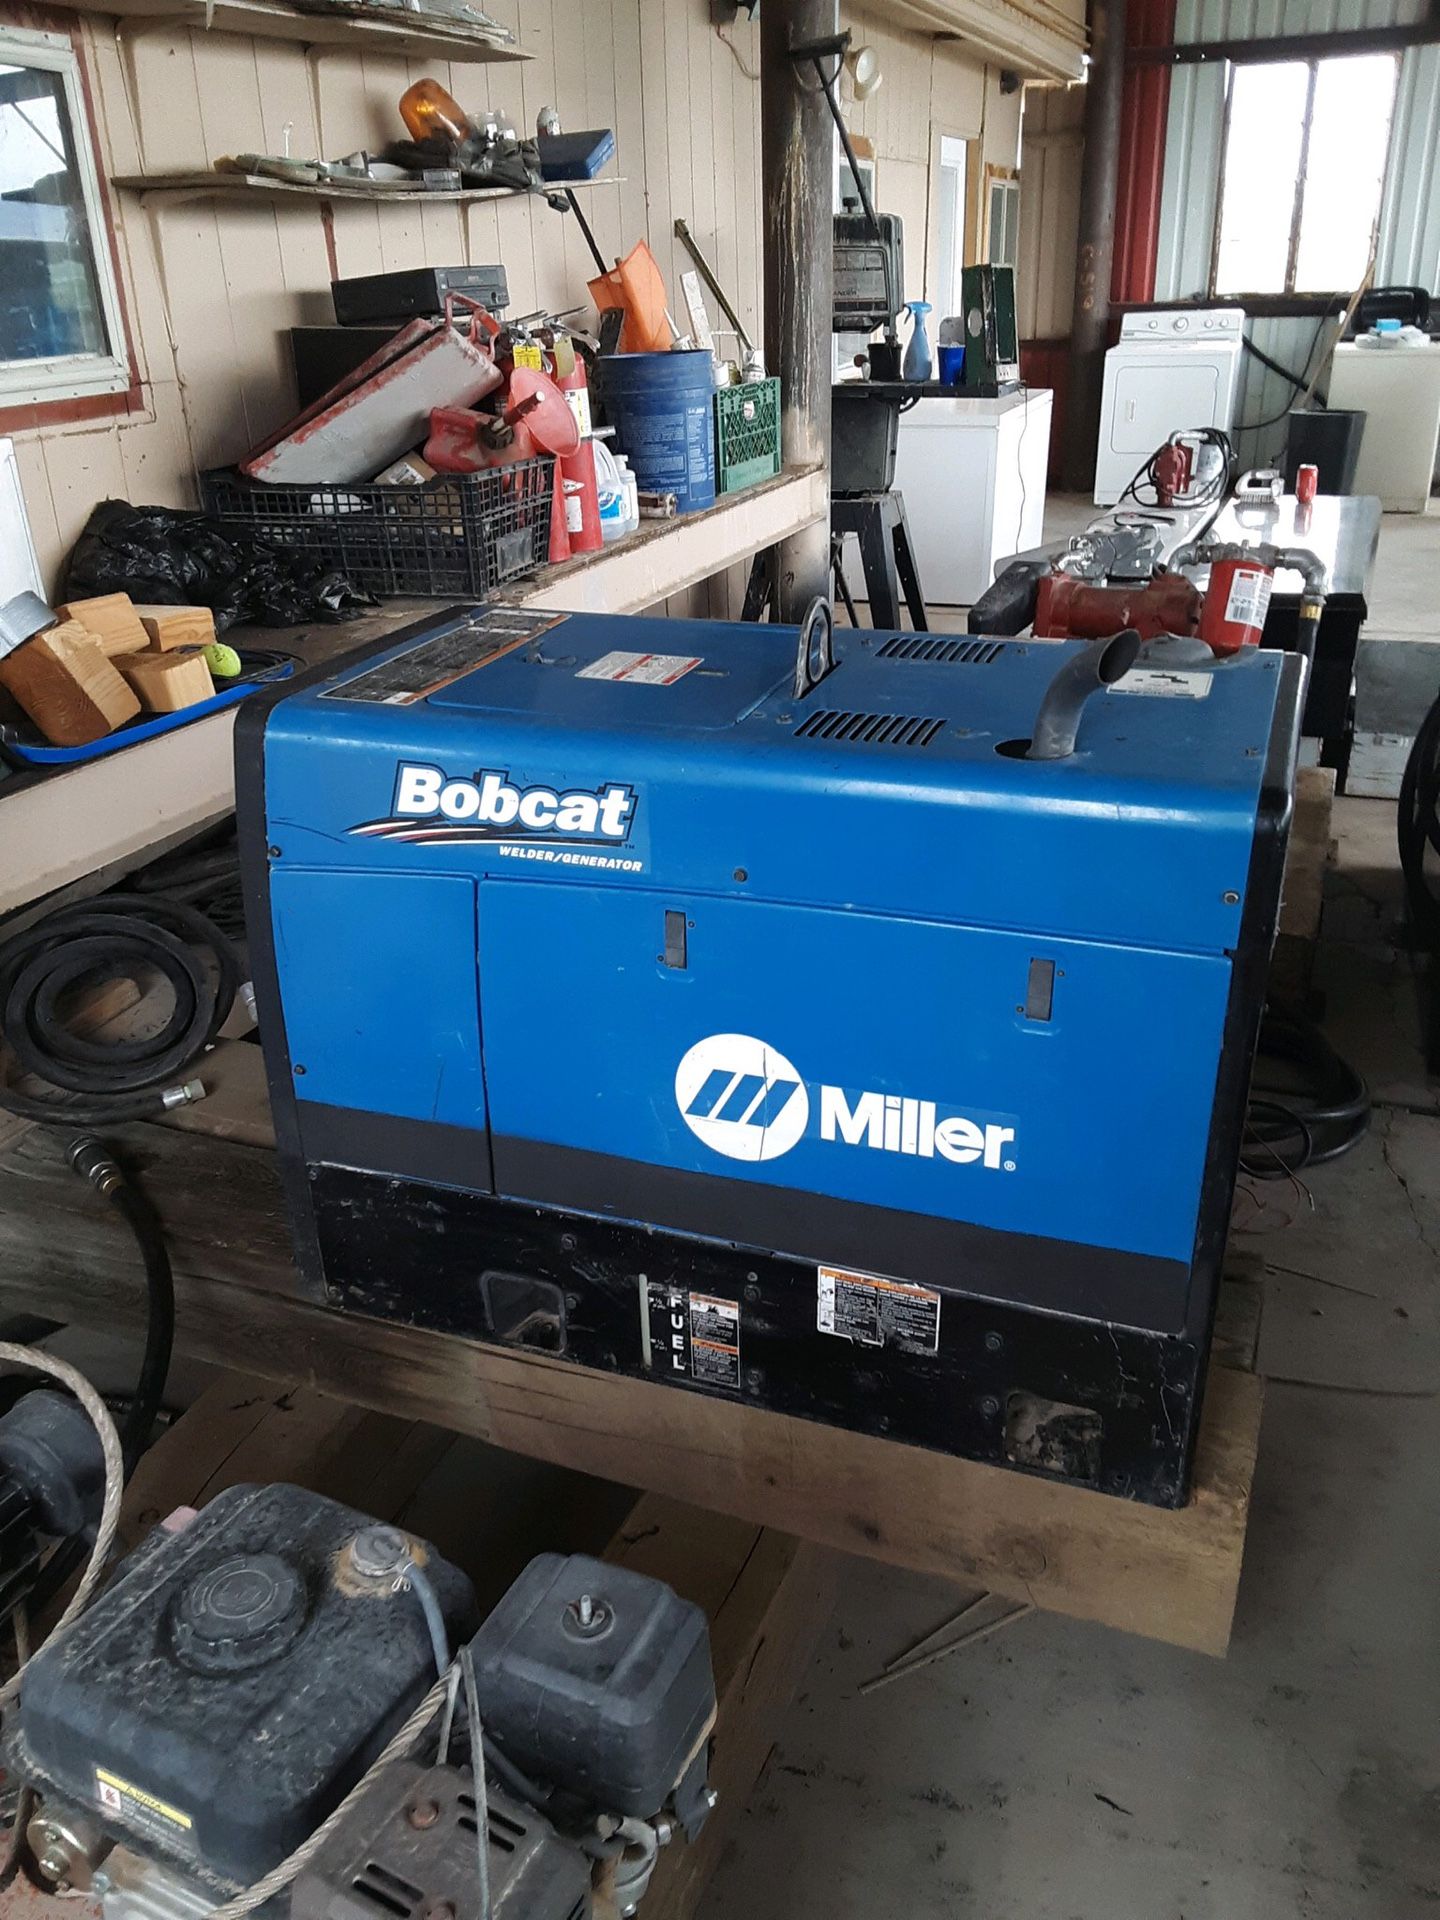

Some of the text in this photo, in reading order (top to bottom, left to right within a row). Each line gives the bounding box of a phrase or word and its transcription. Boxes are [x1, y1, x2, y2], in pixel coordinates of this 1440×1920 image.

[396, 766, 629, 836] Bobcat
[499, 845, 643, 872] WELDER/GENERATOR
[820, 1084, 1015, 1169] Miller
[670, 1294, 686, 1371] FUEL
